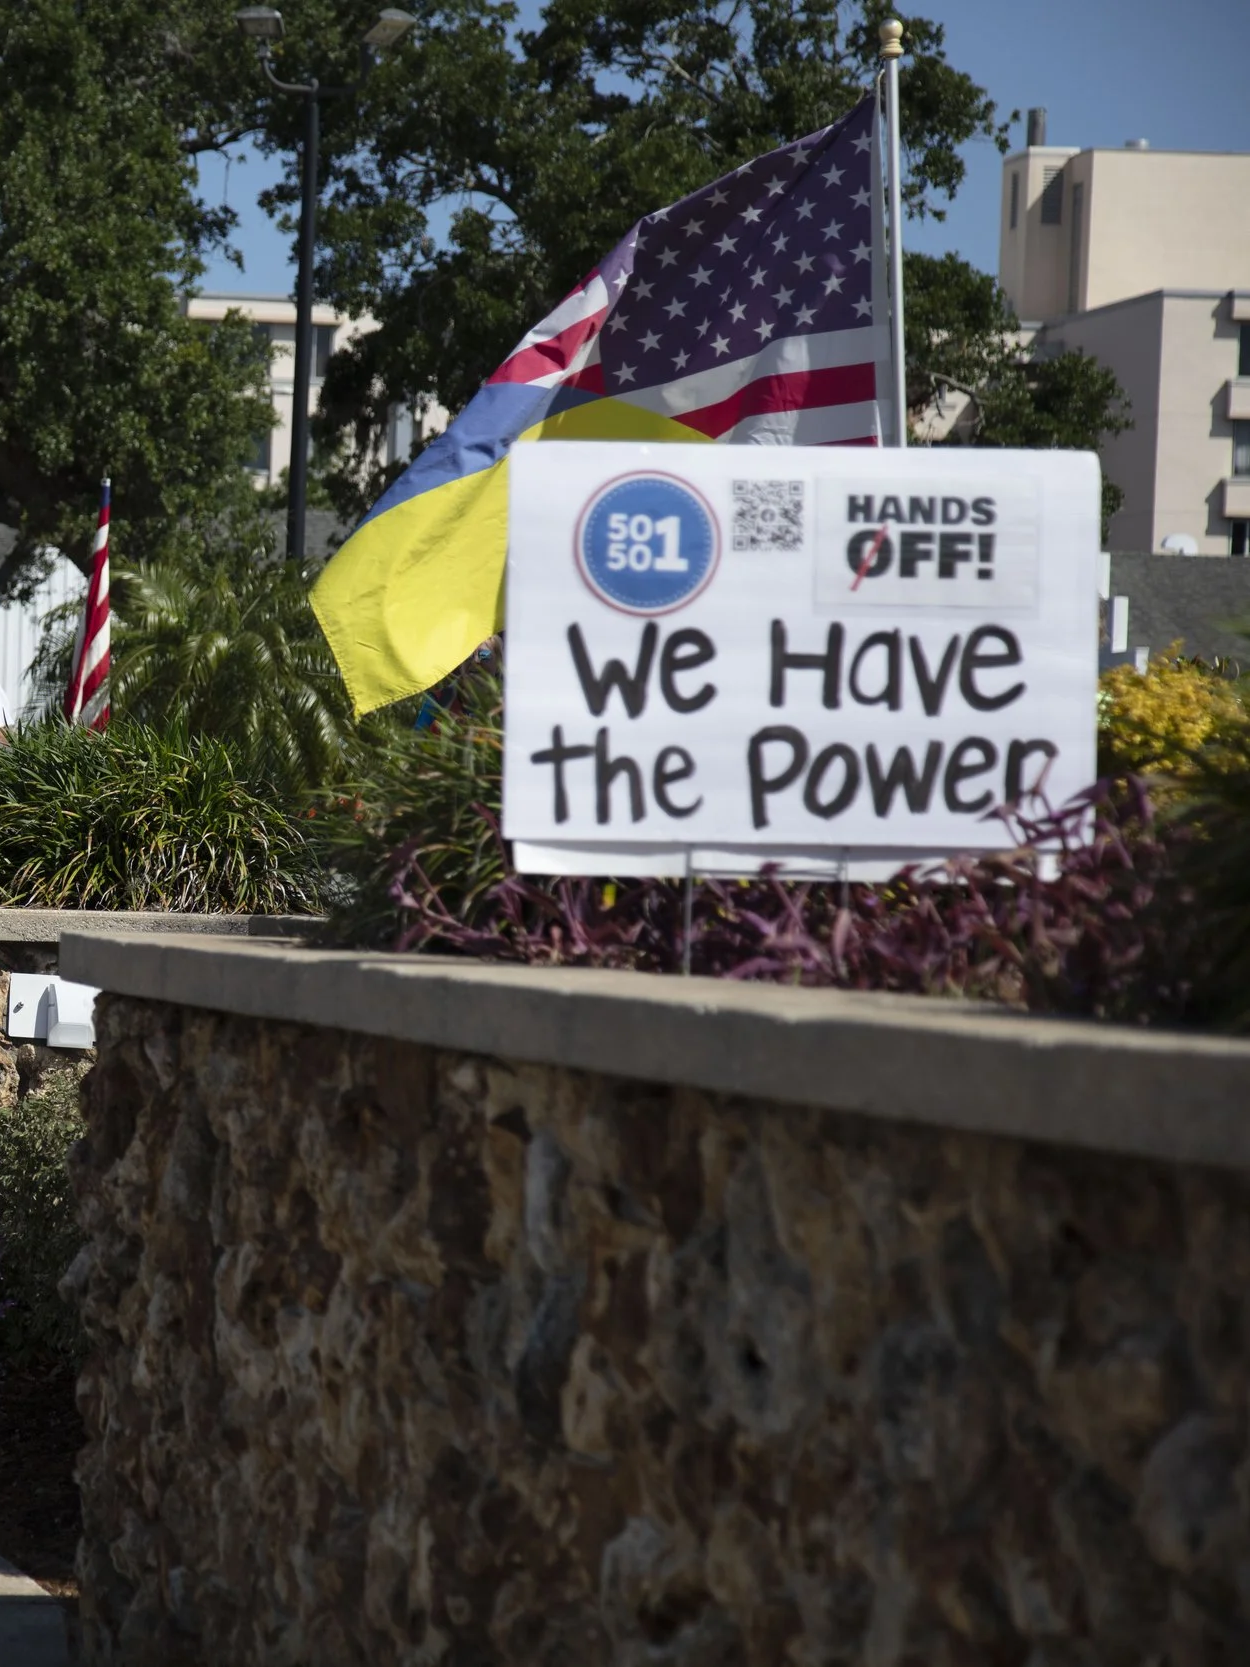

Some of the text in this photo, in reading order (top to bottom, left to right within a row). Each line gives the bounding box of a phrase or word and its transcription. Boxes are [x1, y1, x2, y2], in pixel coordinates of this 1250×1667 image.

[607, 512, 653, 542] 50
[846, 494, 997, 526] HANDS
[607, 542, 653, 572] 50
[654, 515, 689, 571] 1
[845, 531, 996, 581] OFF!
[567, 618, 1027, 719] We Have
[530, 724, 1059, 830] the Power
